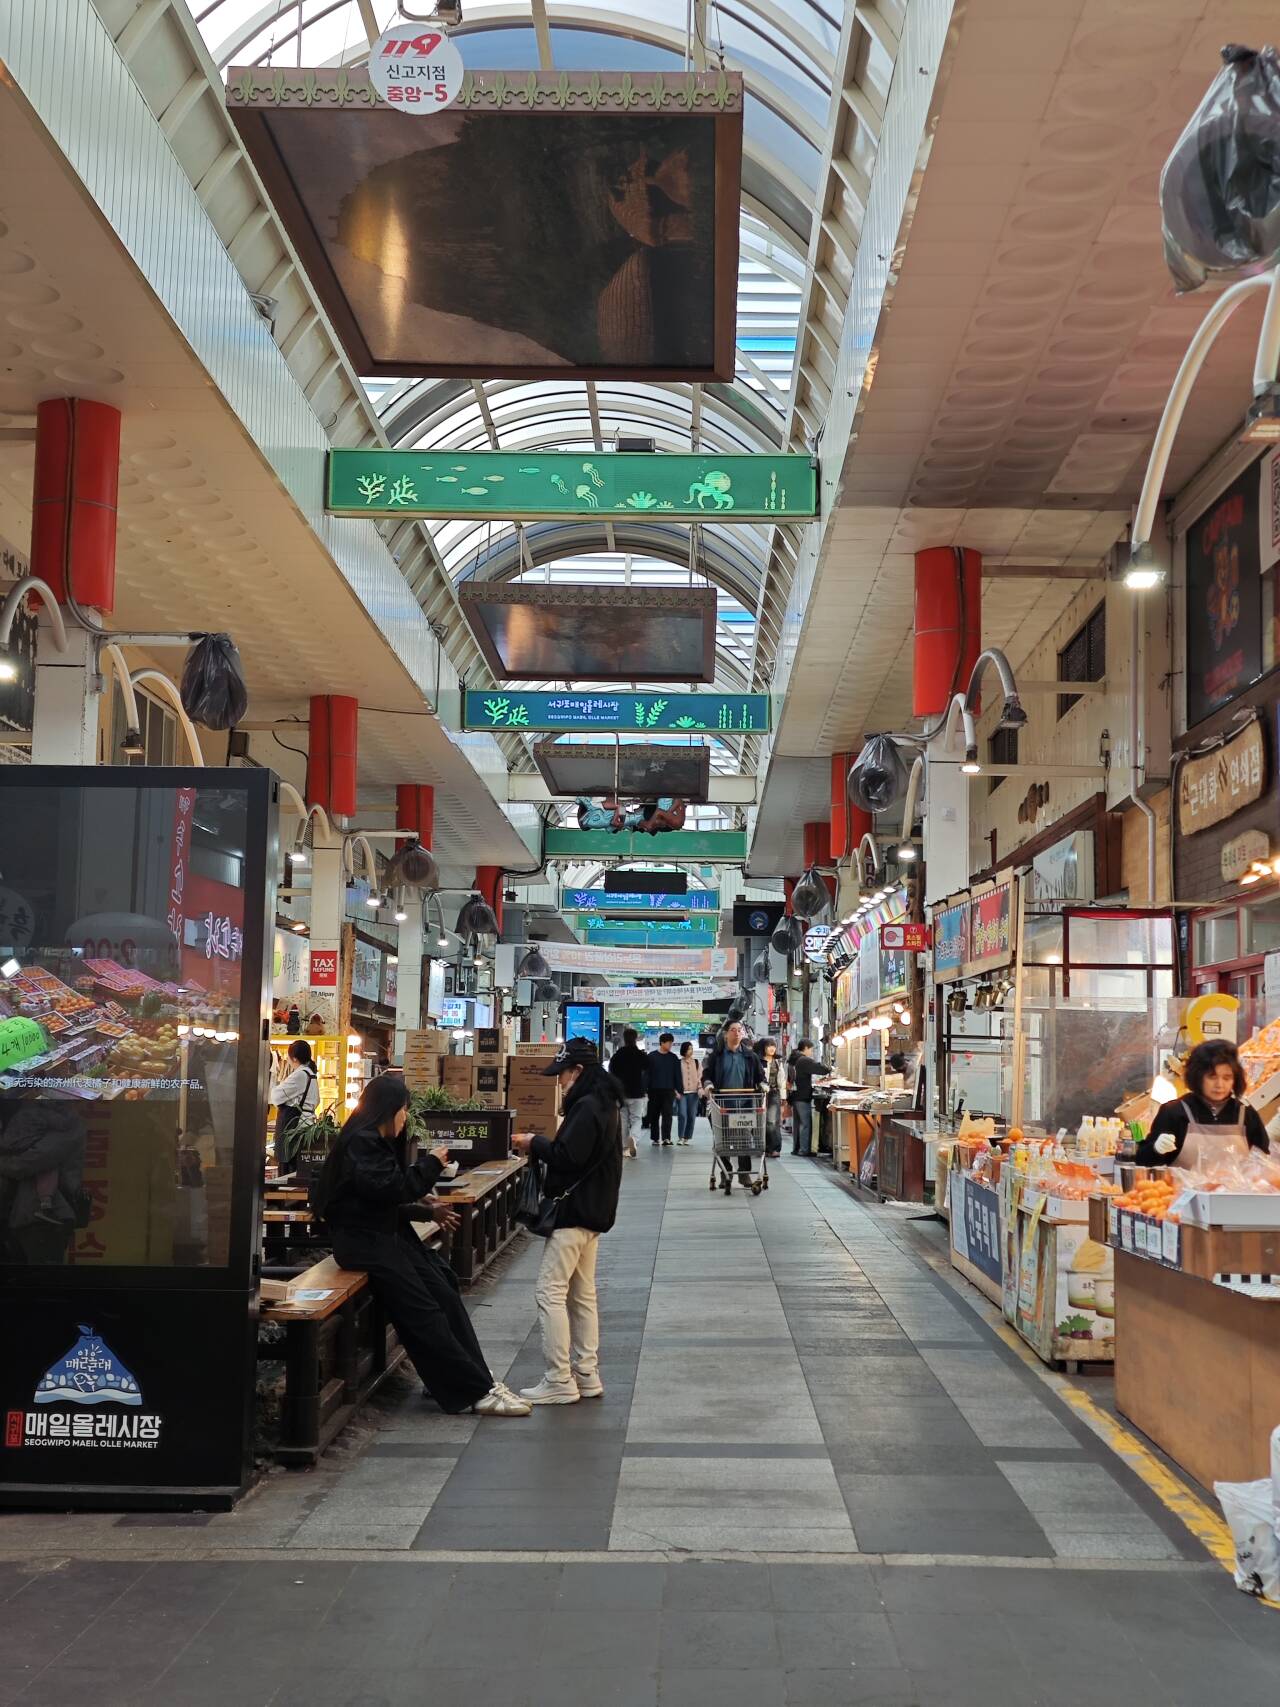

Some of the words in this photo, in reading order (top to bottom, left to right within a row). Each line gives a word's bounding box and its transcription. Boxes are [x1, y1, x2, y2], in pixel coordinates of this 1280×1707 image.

[381, 33, 442, 57] 119
[386, 65, 446, 81] 신고지점
[387, 84, 448, 103] 중앙-5
[547, 699, 620, 714] 서귀포매일올레시장
[312, 958, 335, 968] TAX
[456, 1125, 489, 1139] 상효원
[25, 1412, 162, 1439] 매일올레시장
[24, 1438, 71, 1447] SEOGWIPO
[72, 1439, 99, 1448] MAEIL
[100, 1440, 122, 1448] OLLE
[123, 1441, 158, 1449] MARKET
